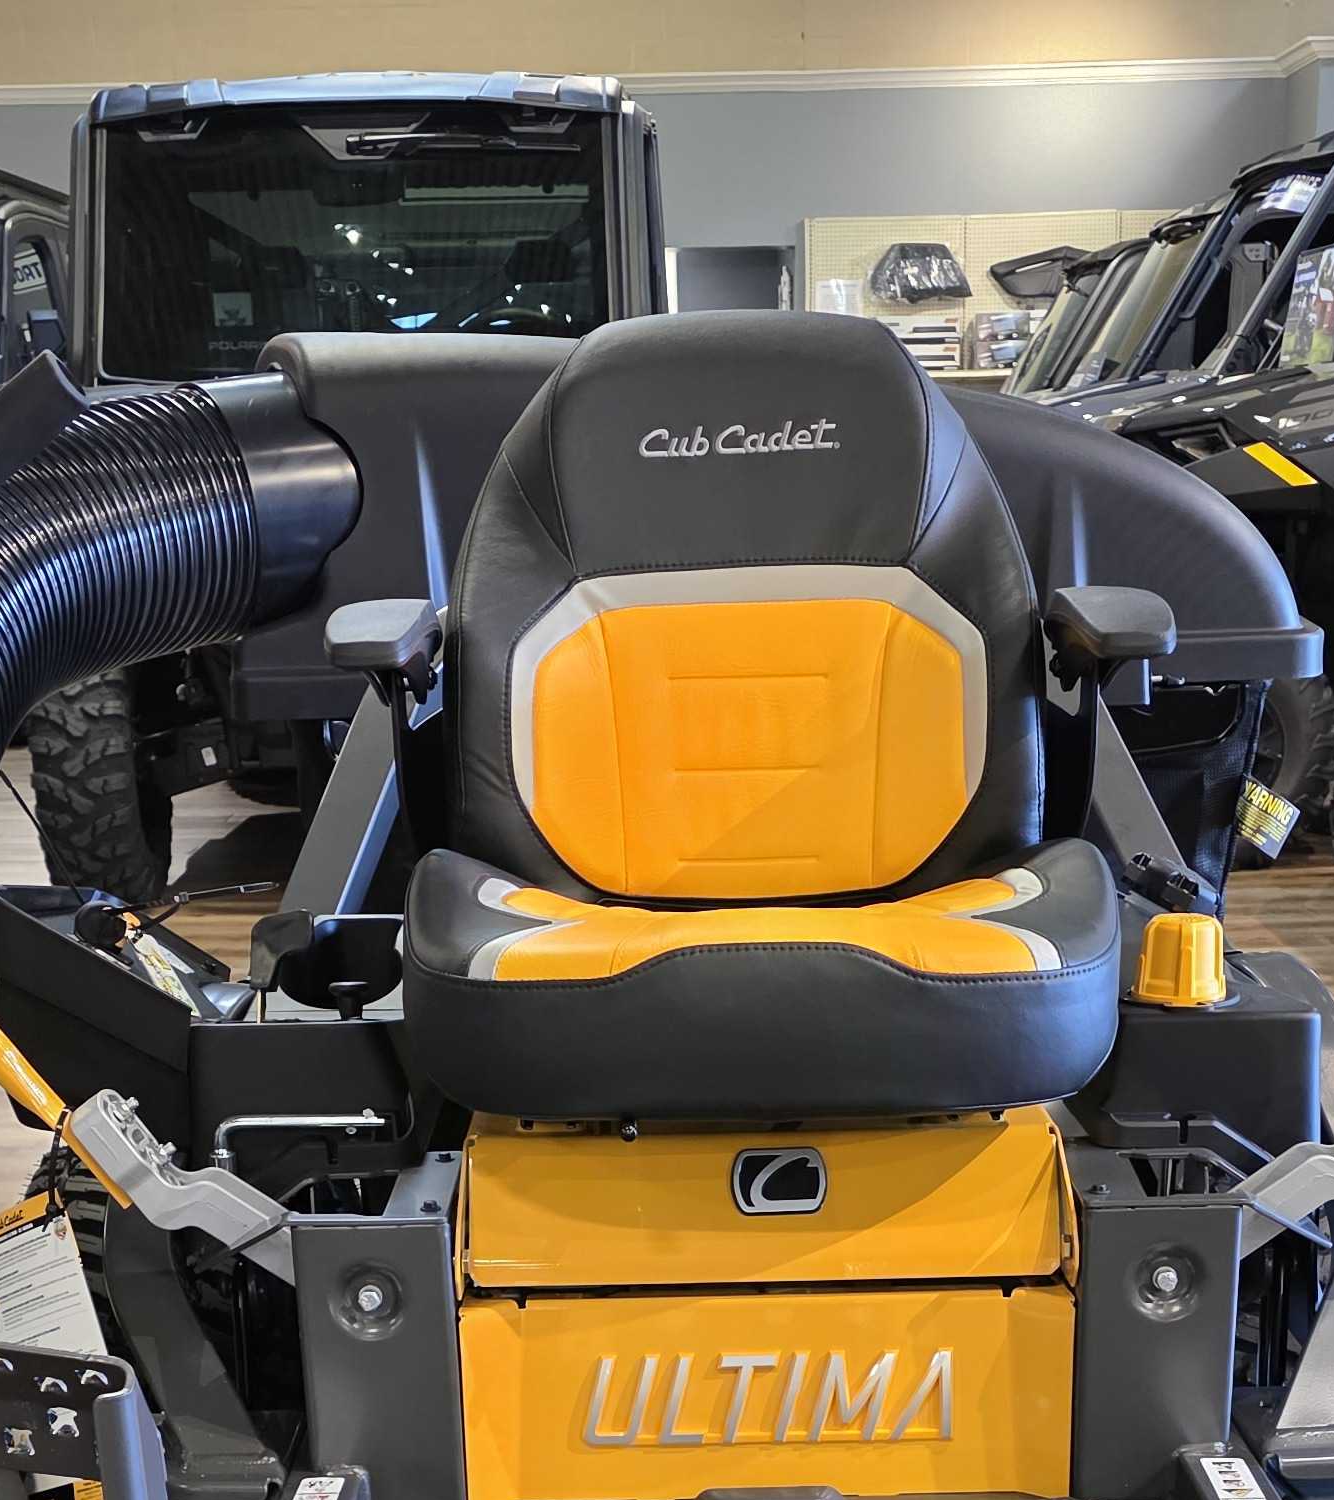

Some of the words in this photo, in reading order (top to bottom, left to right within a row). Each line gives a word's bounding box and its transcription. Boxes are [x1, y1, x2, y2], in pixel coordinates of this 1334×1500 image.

[208, 341, 264, 351] POLAR
[639, 425, 710, 457] Cub
[584, 1348, 954, 1446] ULTIMA
